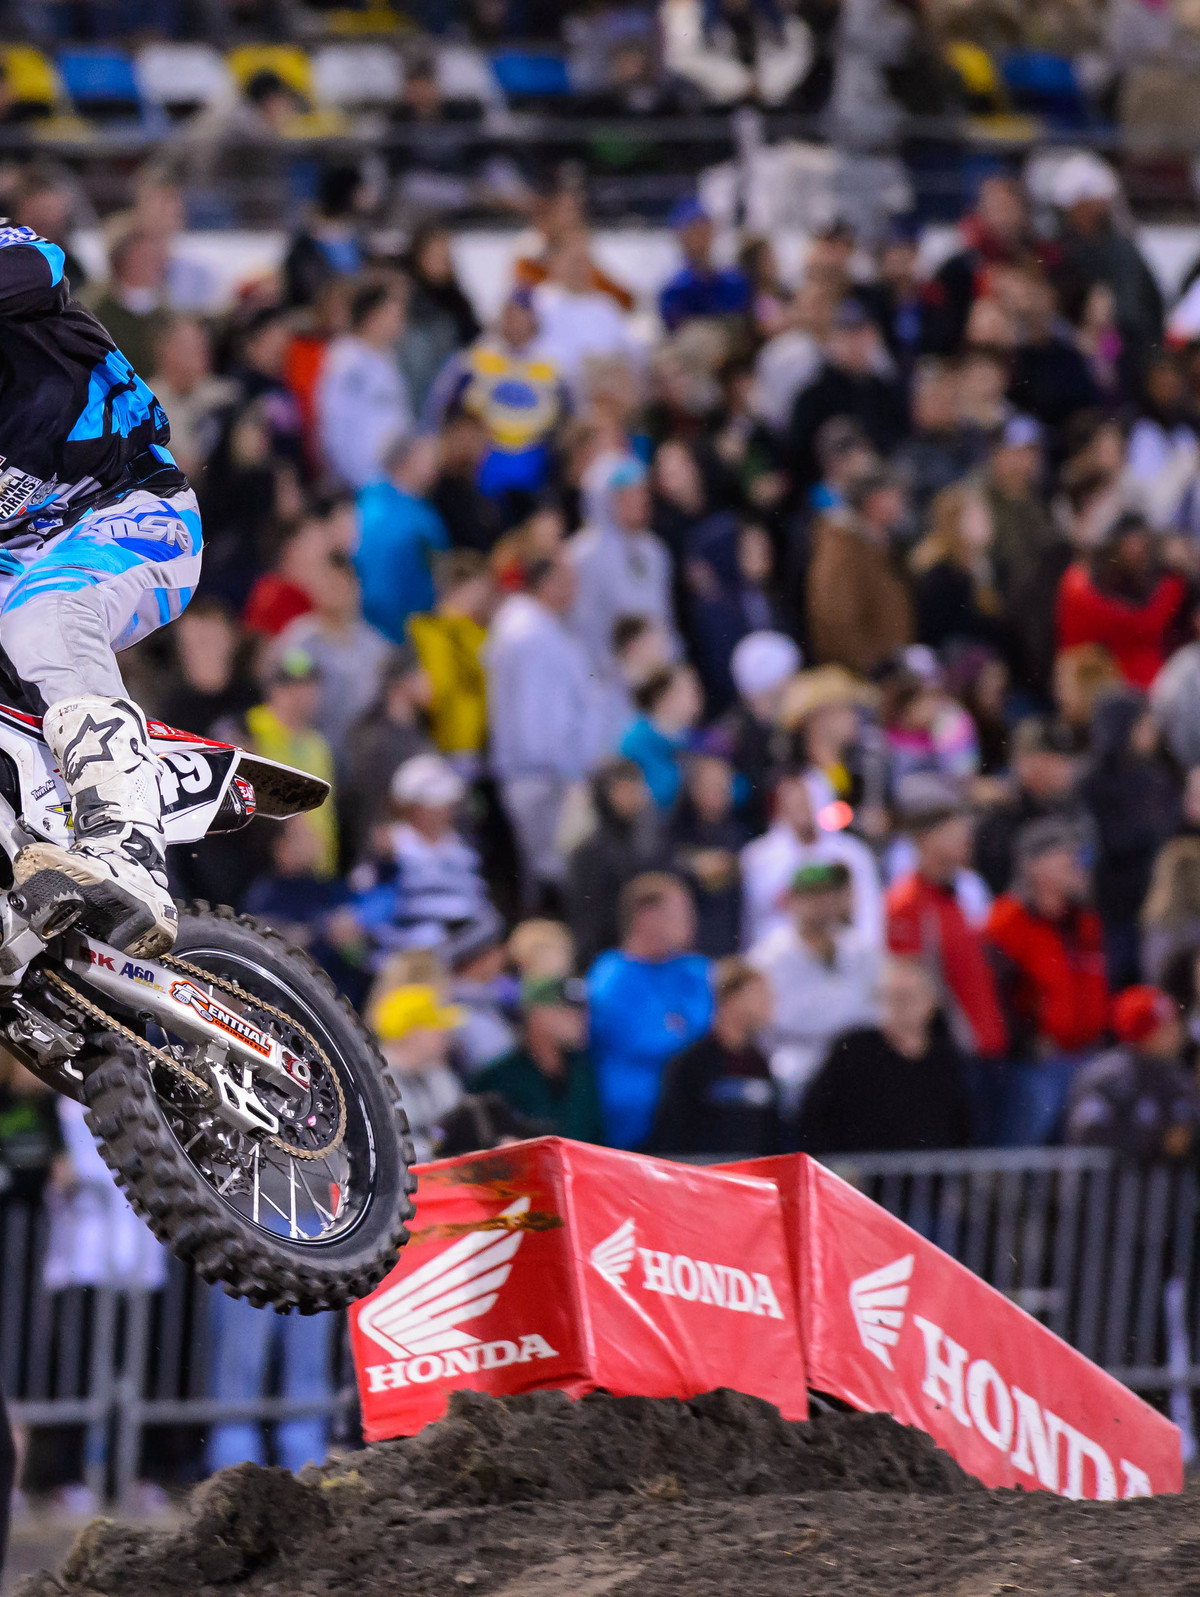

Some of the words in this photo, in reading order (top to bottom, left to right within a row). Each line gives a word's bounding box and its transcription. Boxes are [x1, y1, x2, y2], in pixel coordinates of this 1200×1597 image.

[31, 785, 47, 799] Twin
[45, 779, 56, 790] Air
[80, 945, 116, 972] RK
[119, 962, 154, 983] A60
[637, 1247, 784, 1320] HONDA
[365, 1333, 560, 1393] HONDA
